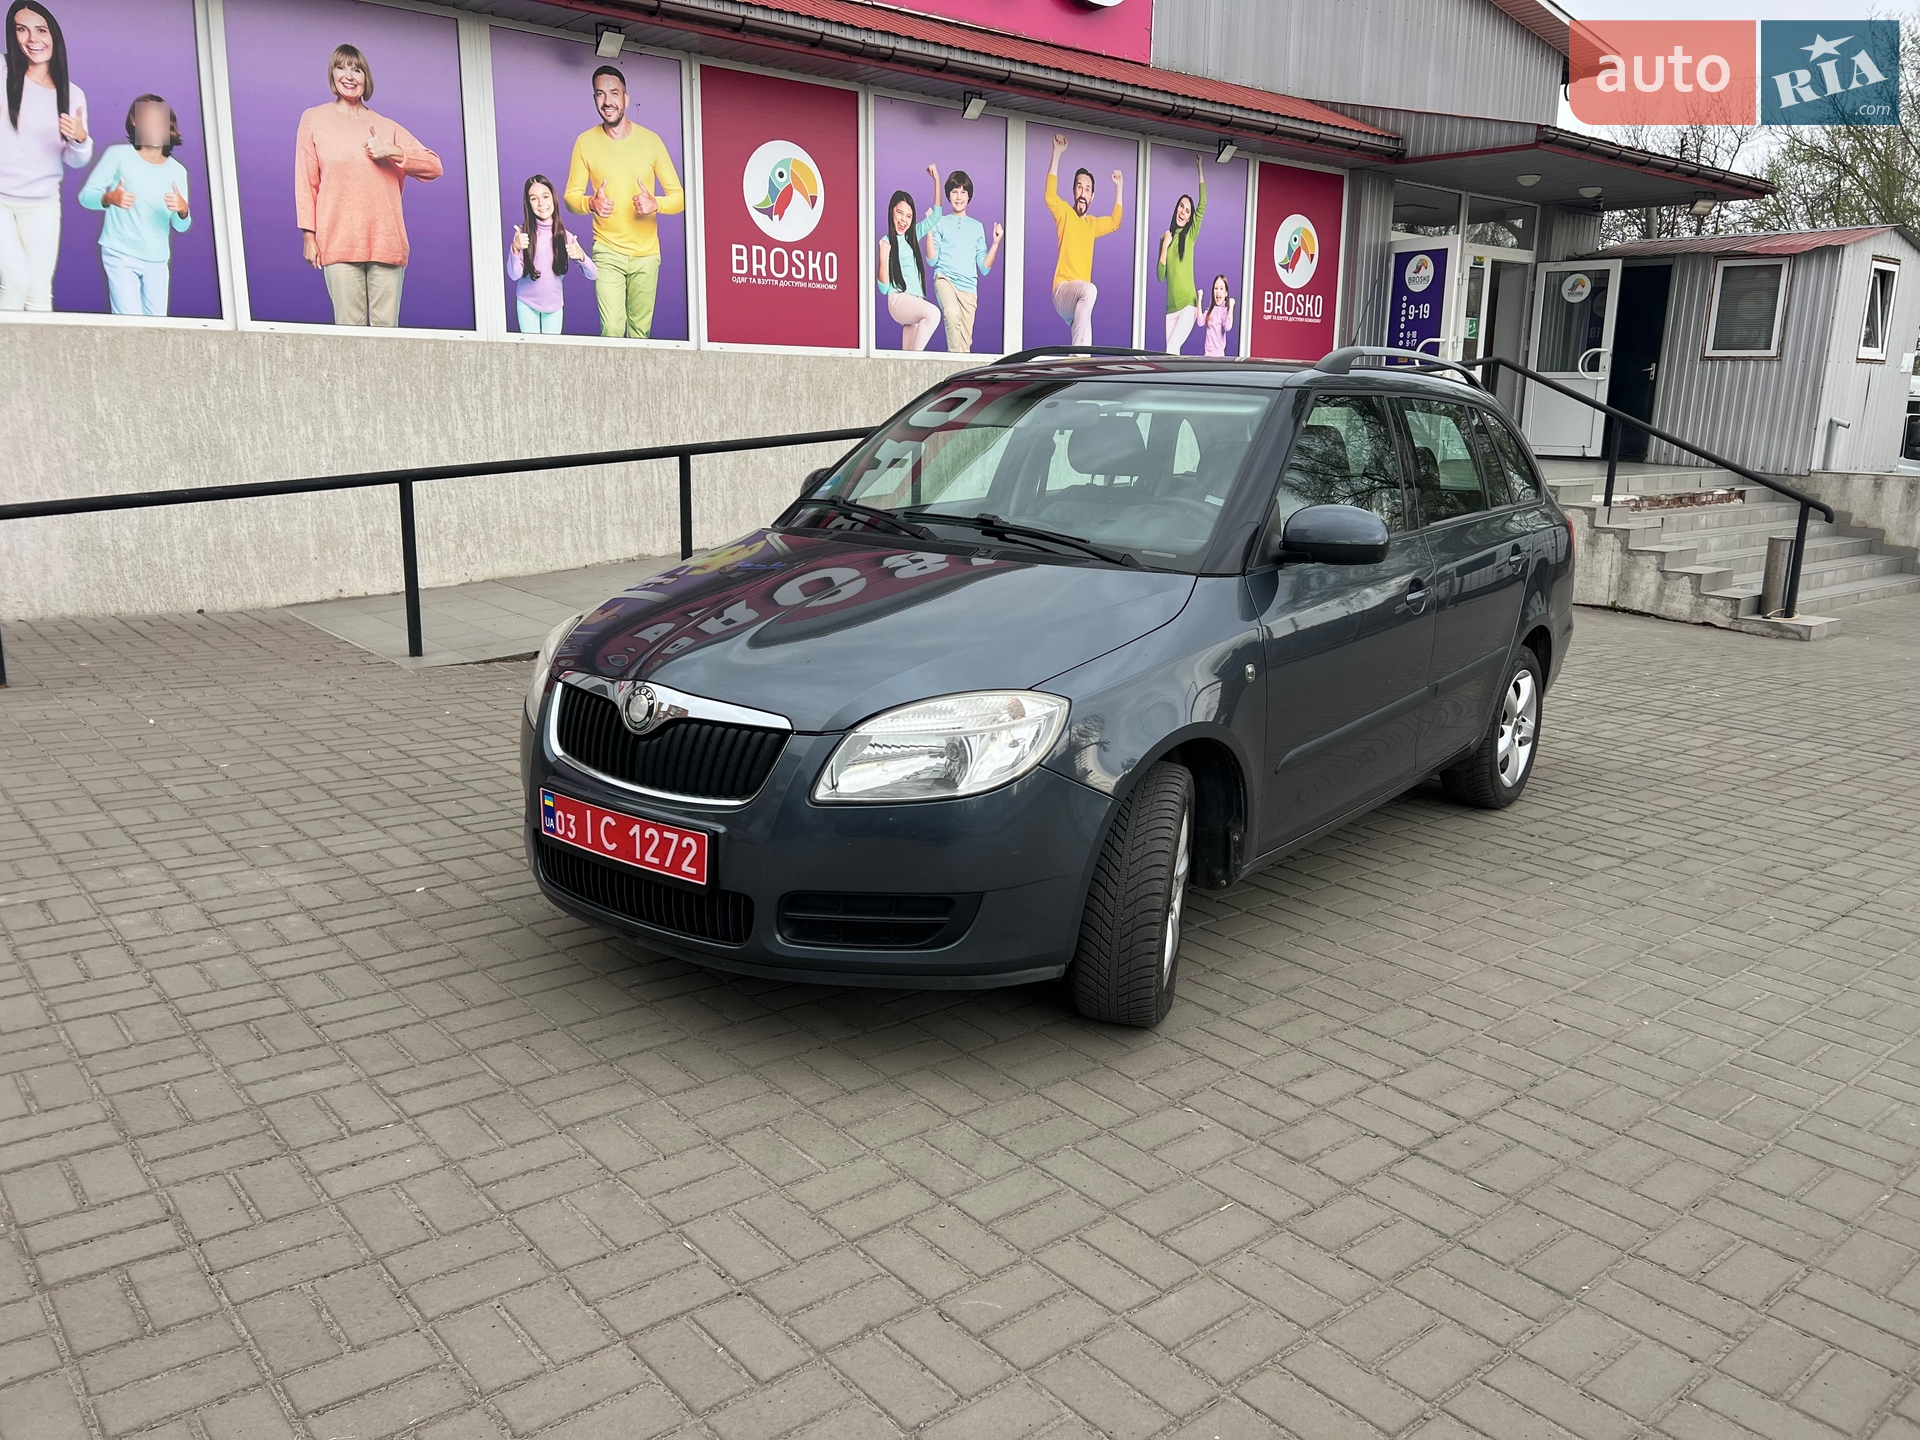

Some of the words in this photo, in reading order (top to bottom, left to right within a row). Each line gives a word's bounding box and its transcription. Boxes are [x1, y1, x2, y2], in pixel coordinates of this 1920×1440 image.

[731, 243, 838, 283] BROSKO
[731, 276, 748, 284] ОДЯГ
[757, 278, 779, 286] ВЗУТТЯ
[779, 280, 808, 288] ДОСТУПНІ
[808, 282, 838, 291] КОЖНОМУ
[1263, 290, 1323, 318] BROSKO
[1408, 303, 1430, 320] 9-19
[544, 816, 555, 829] UA
[555, 810, 577, 839] 03
[628, 824, 698, 875] 1272
